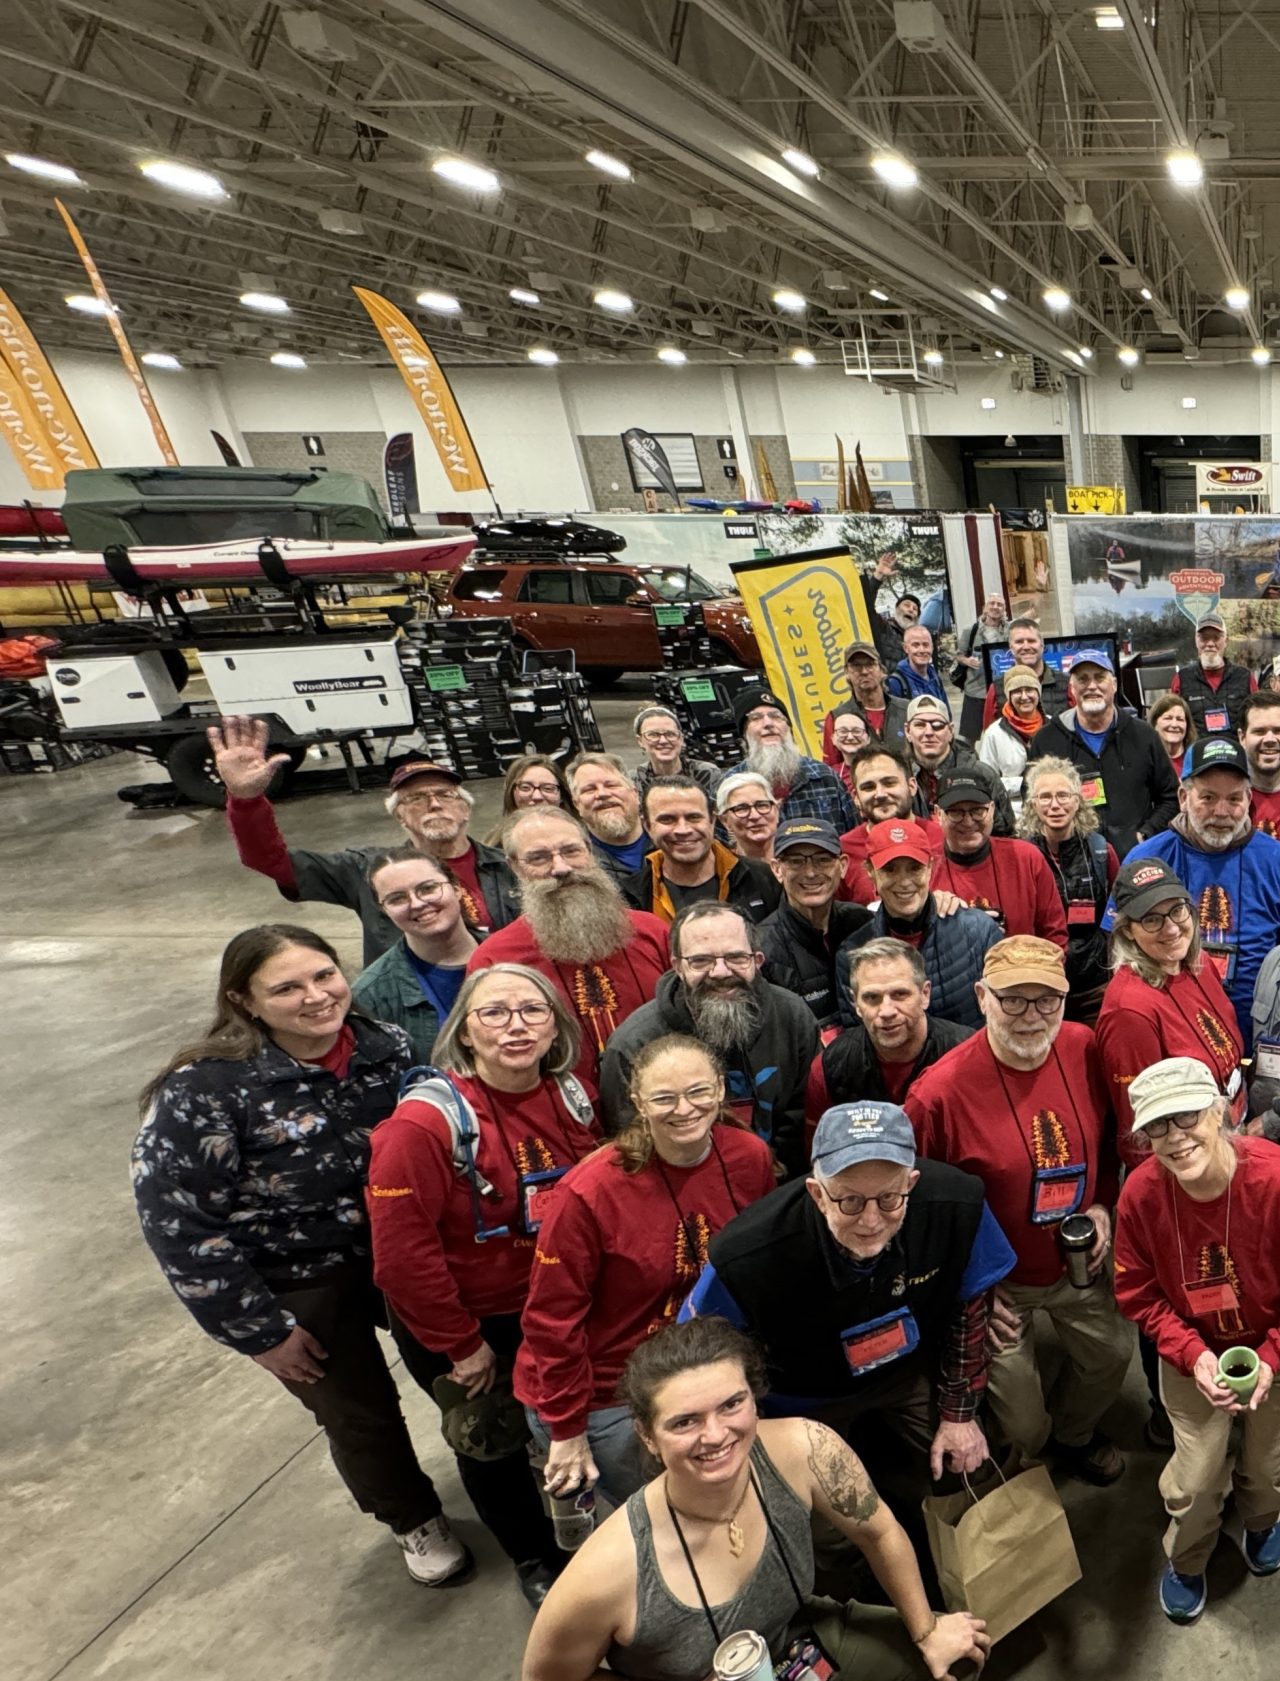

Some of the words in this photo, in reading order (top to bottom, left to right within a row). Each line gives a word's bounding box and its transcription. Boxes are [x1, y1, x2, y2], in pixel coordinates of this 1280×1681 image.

[1231, 470, 1256, 481] Swift
[728, 526, 754, 535] THULE
[912, 526, 939, 535] THULE
[1171, 575, 1222, 583] OUTDOOR
[296, 680, 360, 693] WoollyBear
